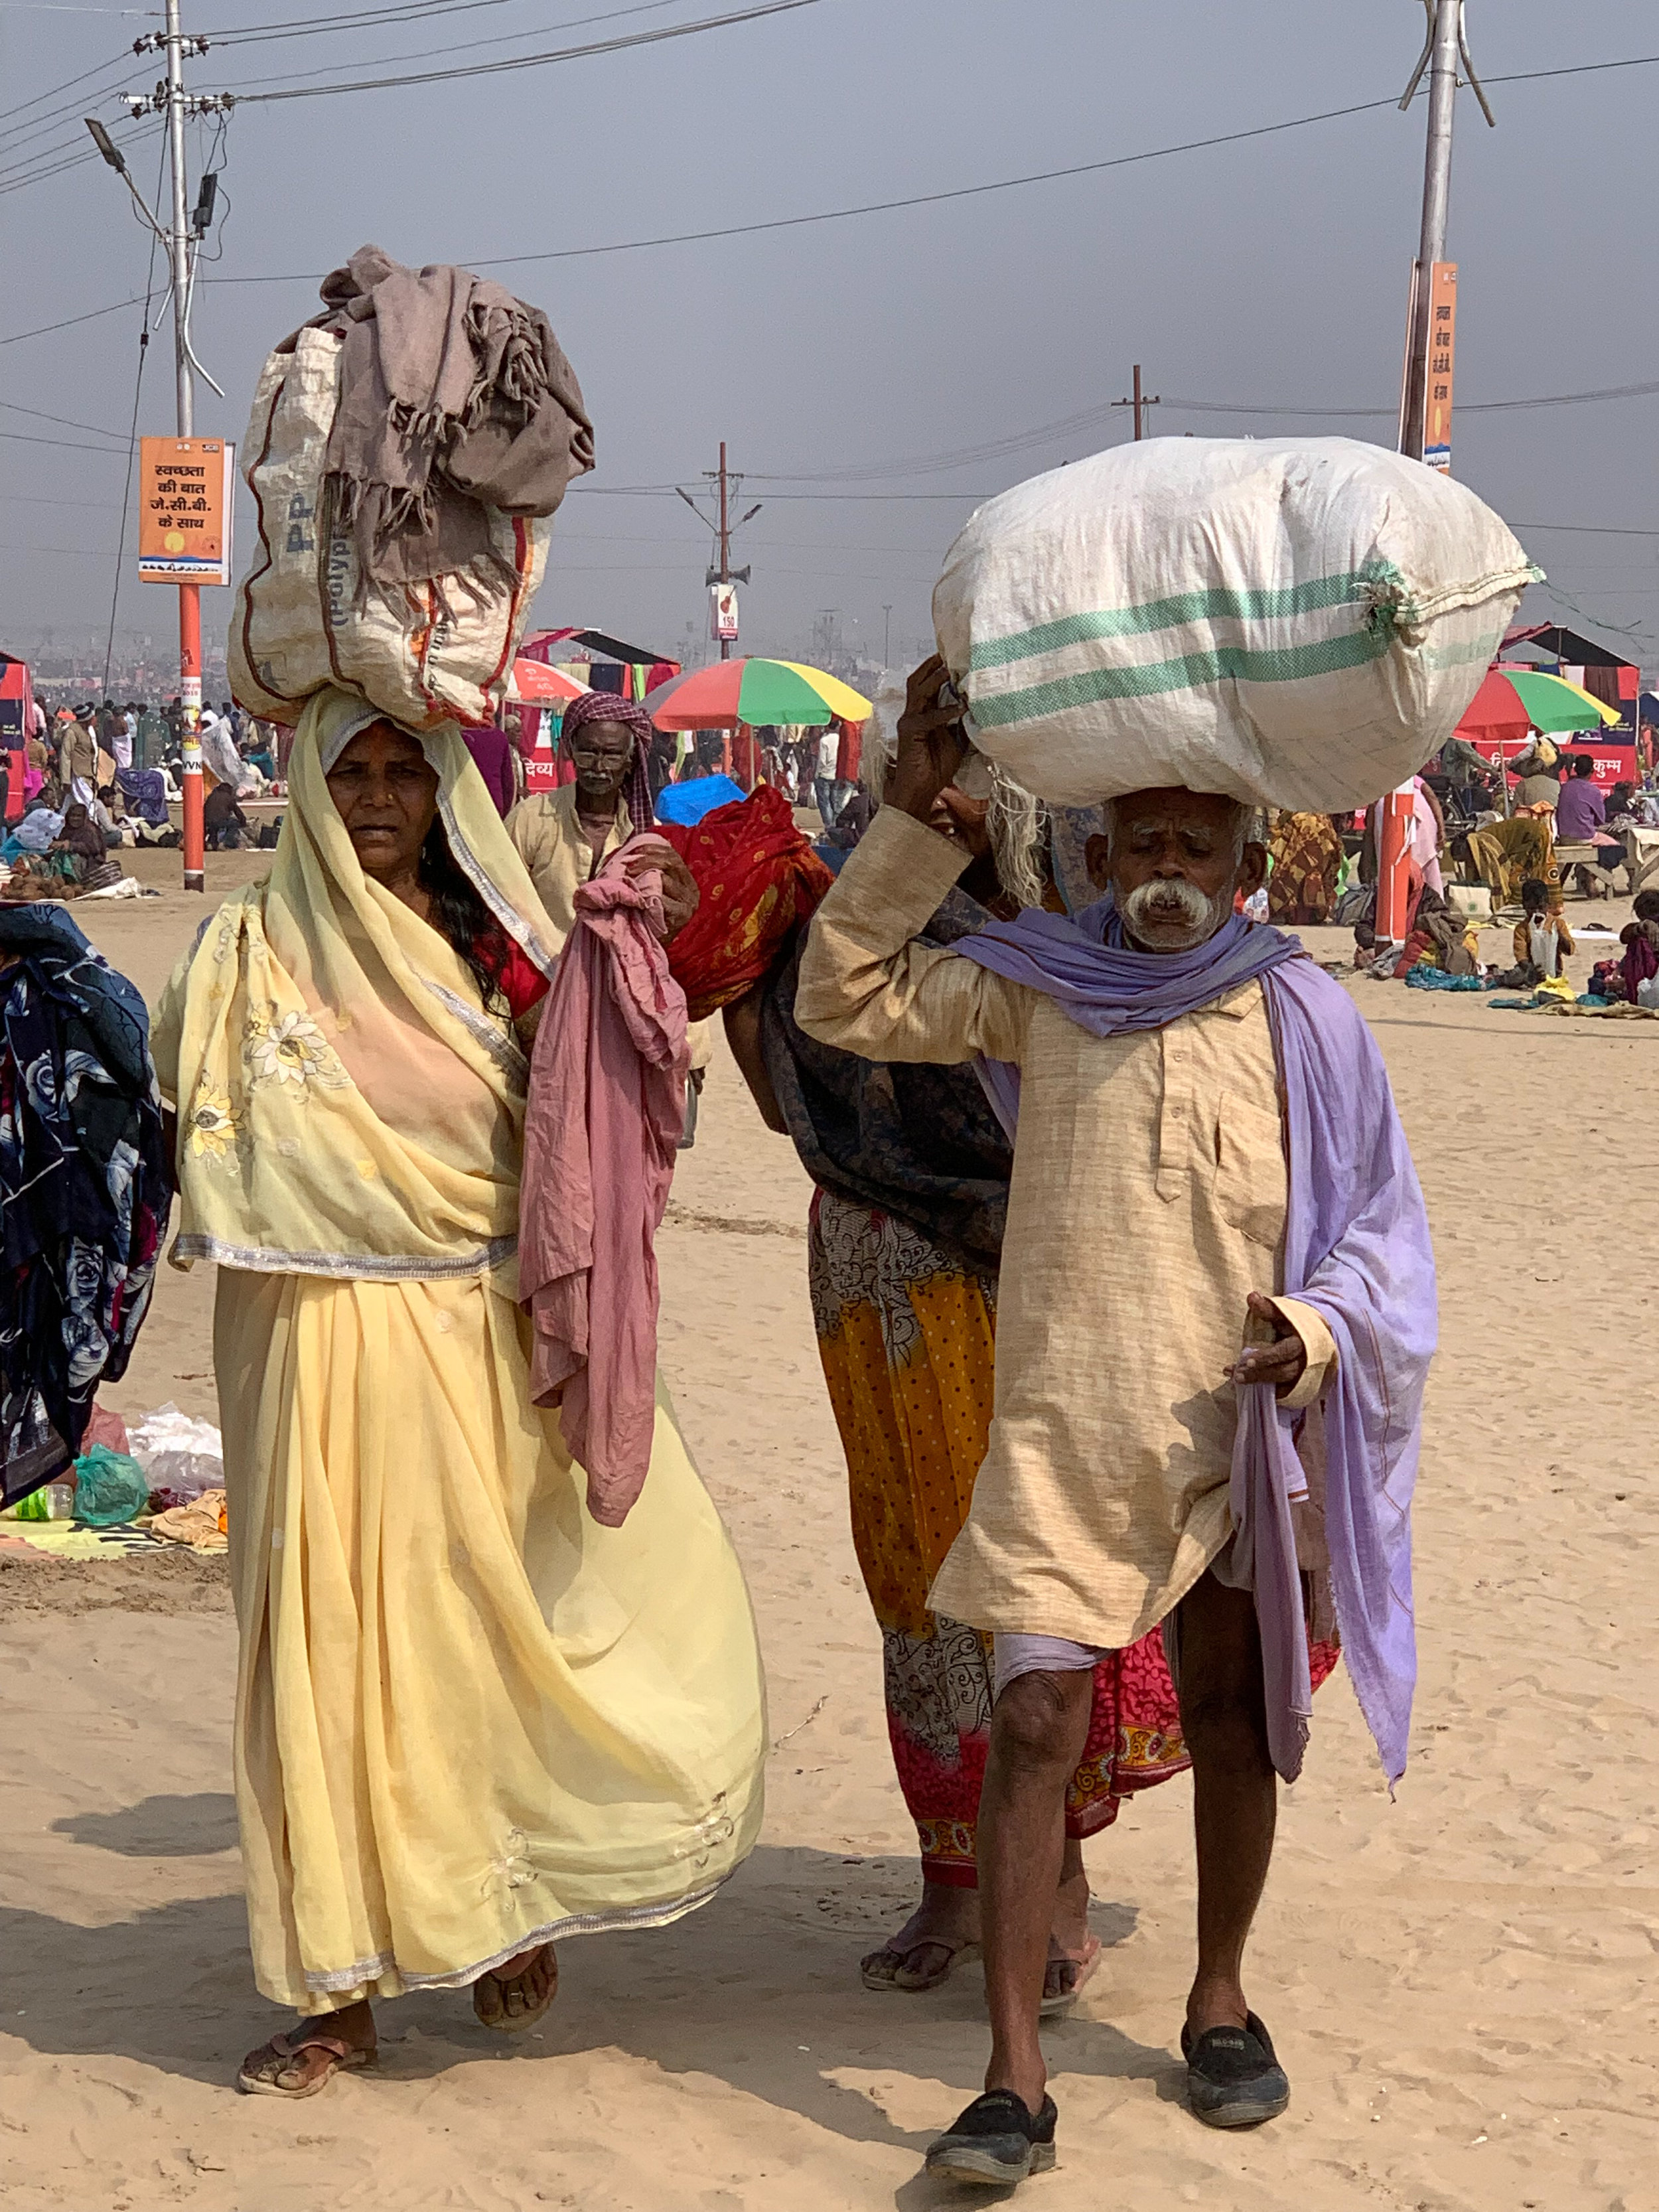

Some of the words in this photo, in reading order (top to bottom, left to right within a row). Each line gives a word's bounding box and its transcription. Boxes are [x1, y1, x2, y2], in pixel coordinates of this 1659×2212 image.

[155, 465, 205, 477] स्वच्छता
[157, 479, 177, 493] की
[180, 484, 206, 494] बात
[150, 497, 212, 511] जे.सी.बी.
[158, 514, 173, 528] के
[177, 518, 204, 528] साथ
[287, 492, 314, 552] PP
[1593, 759, 1622, 779] कुम्भ
